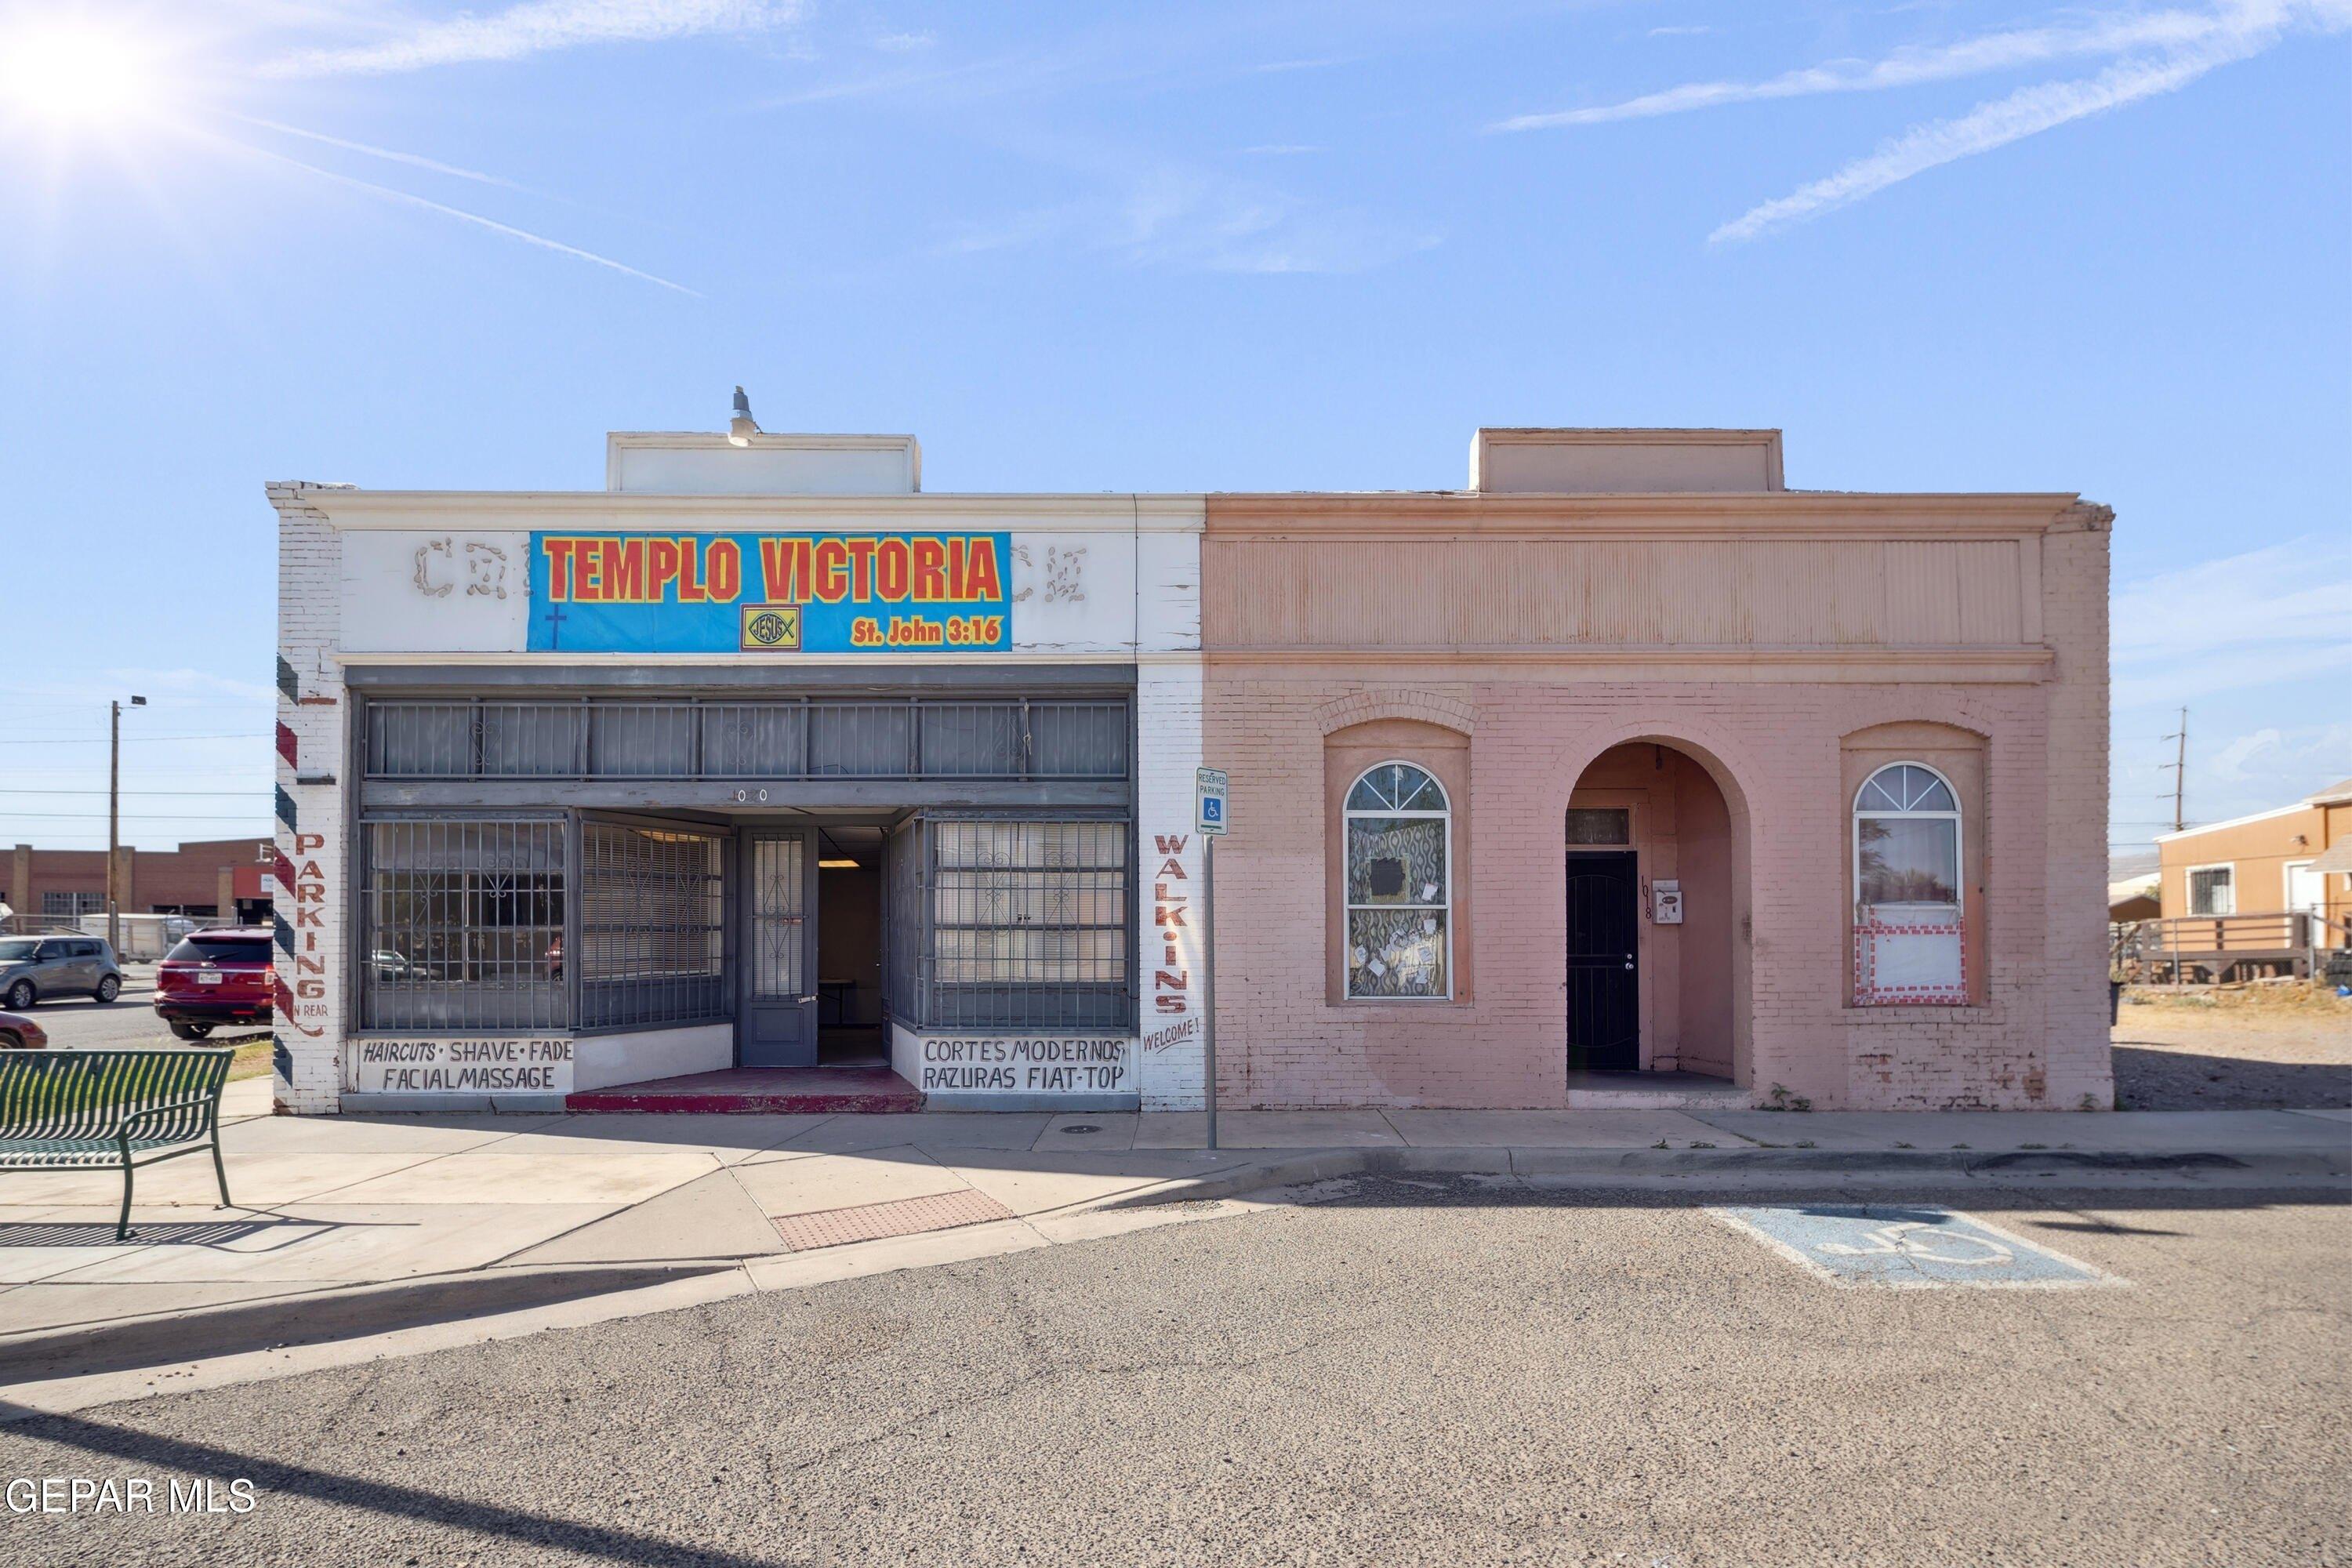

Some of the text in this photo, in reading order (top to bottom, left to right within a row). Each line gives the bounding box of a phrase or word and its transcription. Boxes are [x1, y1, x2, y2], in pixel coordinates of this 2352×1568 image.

[543, 536, 741, 603] TEMPLO
[759, 537, 1003, 603] VICTORIA
[753, 615, 782, 641] JESUS
[850, 615, 1004, 646] St. John 3:16
[1198, 773, 1226, 785] RESERVED
[1200, 785, 1225, 796] PARKING
[1642, 875, 1651, 919] 1018
[296, 834, 325, 999] PARKING
[304, 1004, 328, 1017] REAR
[363, 1040, 573, 1063] HAIRCUTS SHAVE FADE
[924, 1040, 1125, 1062] CORTES MODERNOS
[382, 1067, 555, 1091] FACIAL MASSAGE
[922, 1067, 1017, 1090] RAZURAS
